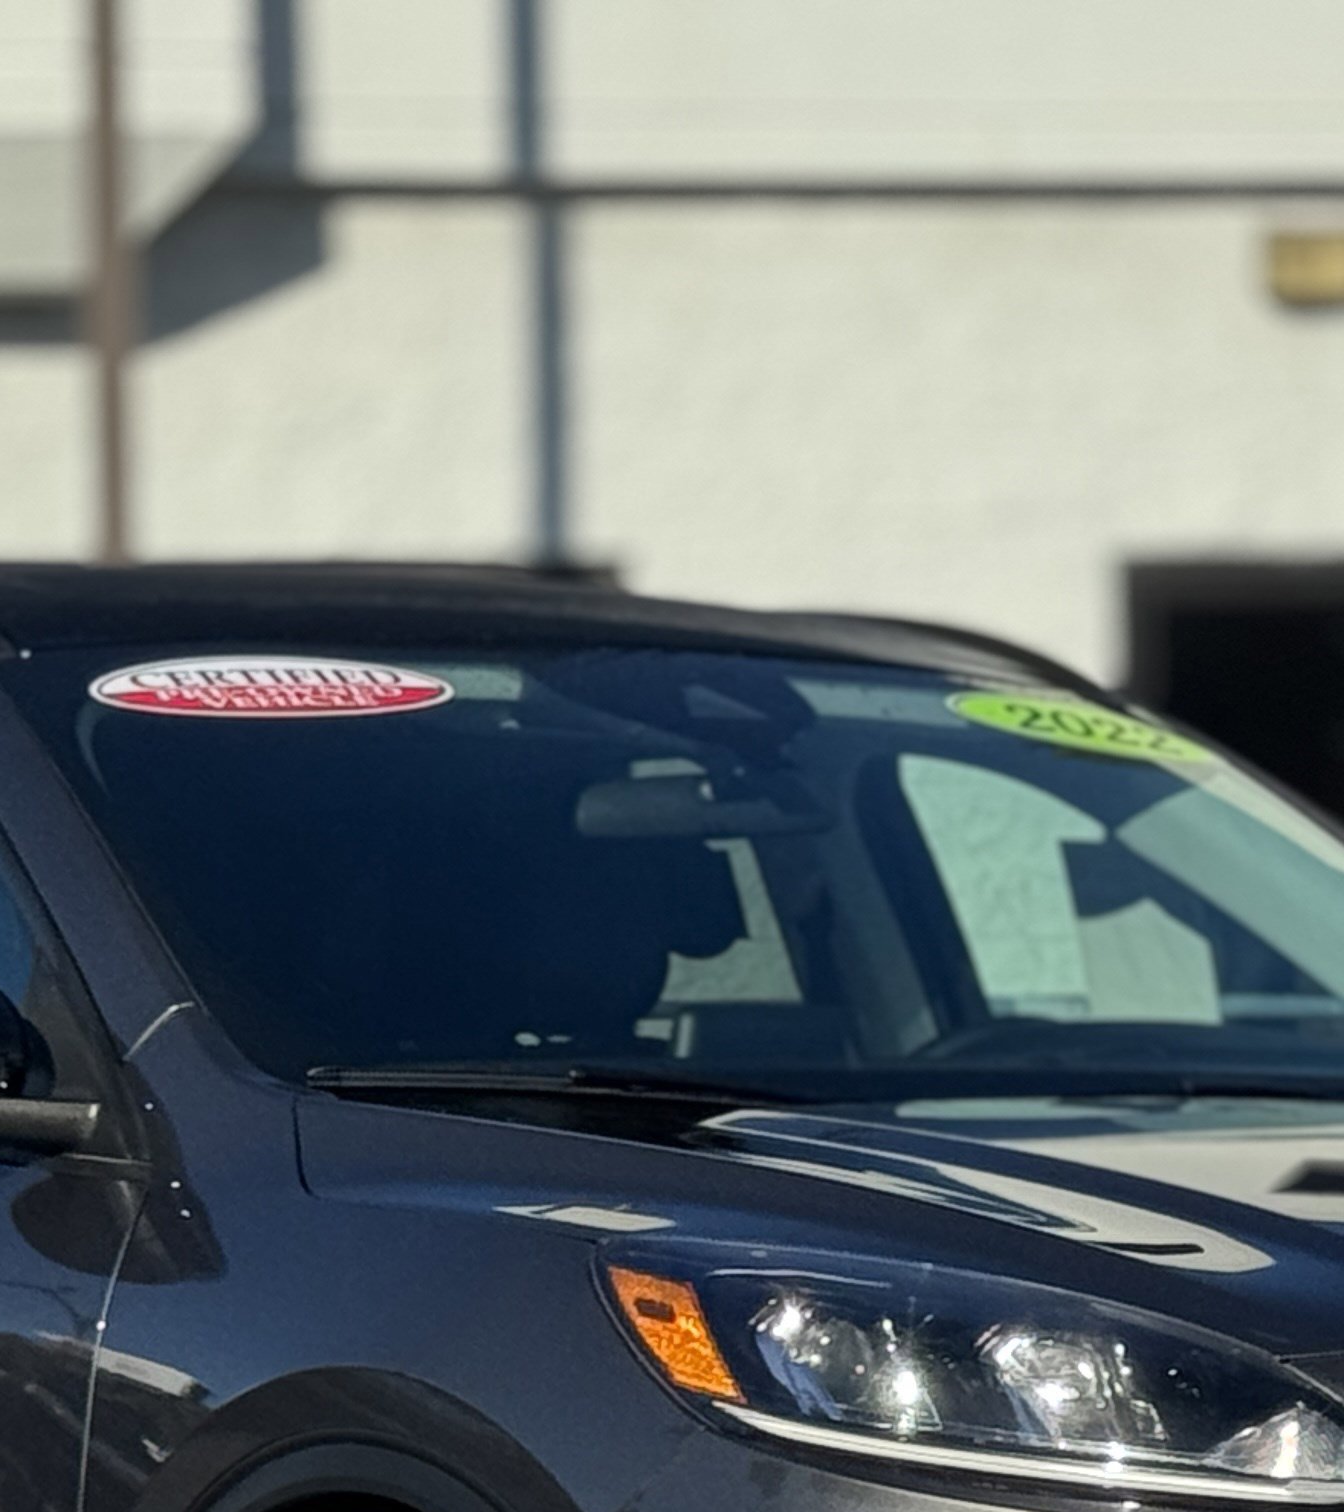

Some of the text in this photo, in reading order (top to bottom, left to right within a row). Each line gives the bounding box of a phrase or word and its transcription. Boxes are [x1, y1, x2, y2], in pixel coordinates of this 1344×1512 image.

[130, 668, 402, 689] CERTIFIED
[201, 690, 380, 709] VEHICLE
[1005, 703, 1184, 756] 2022
